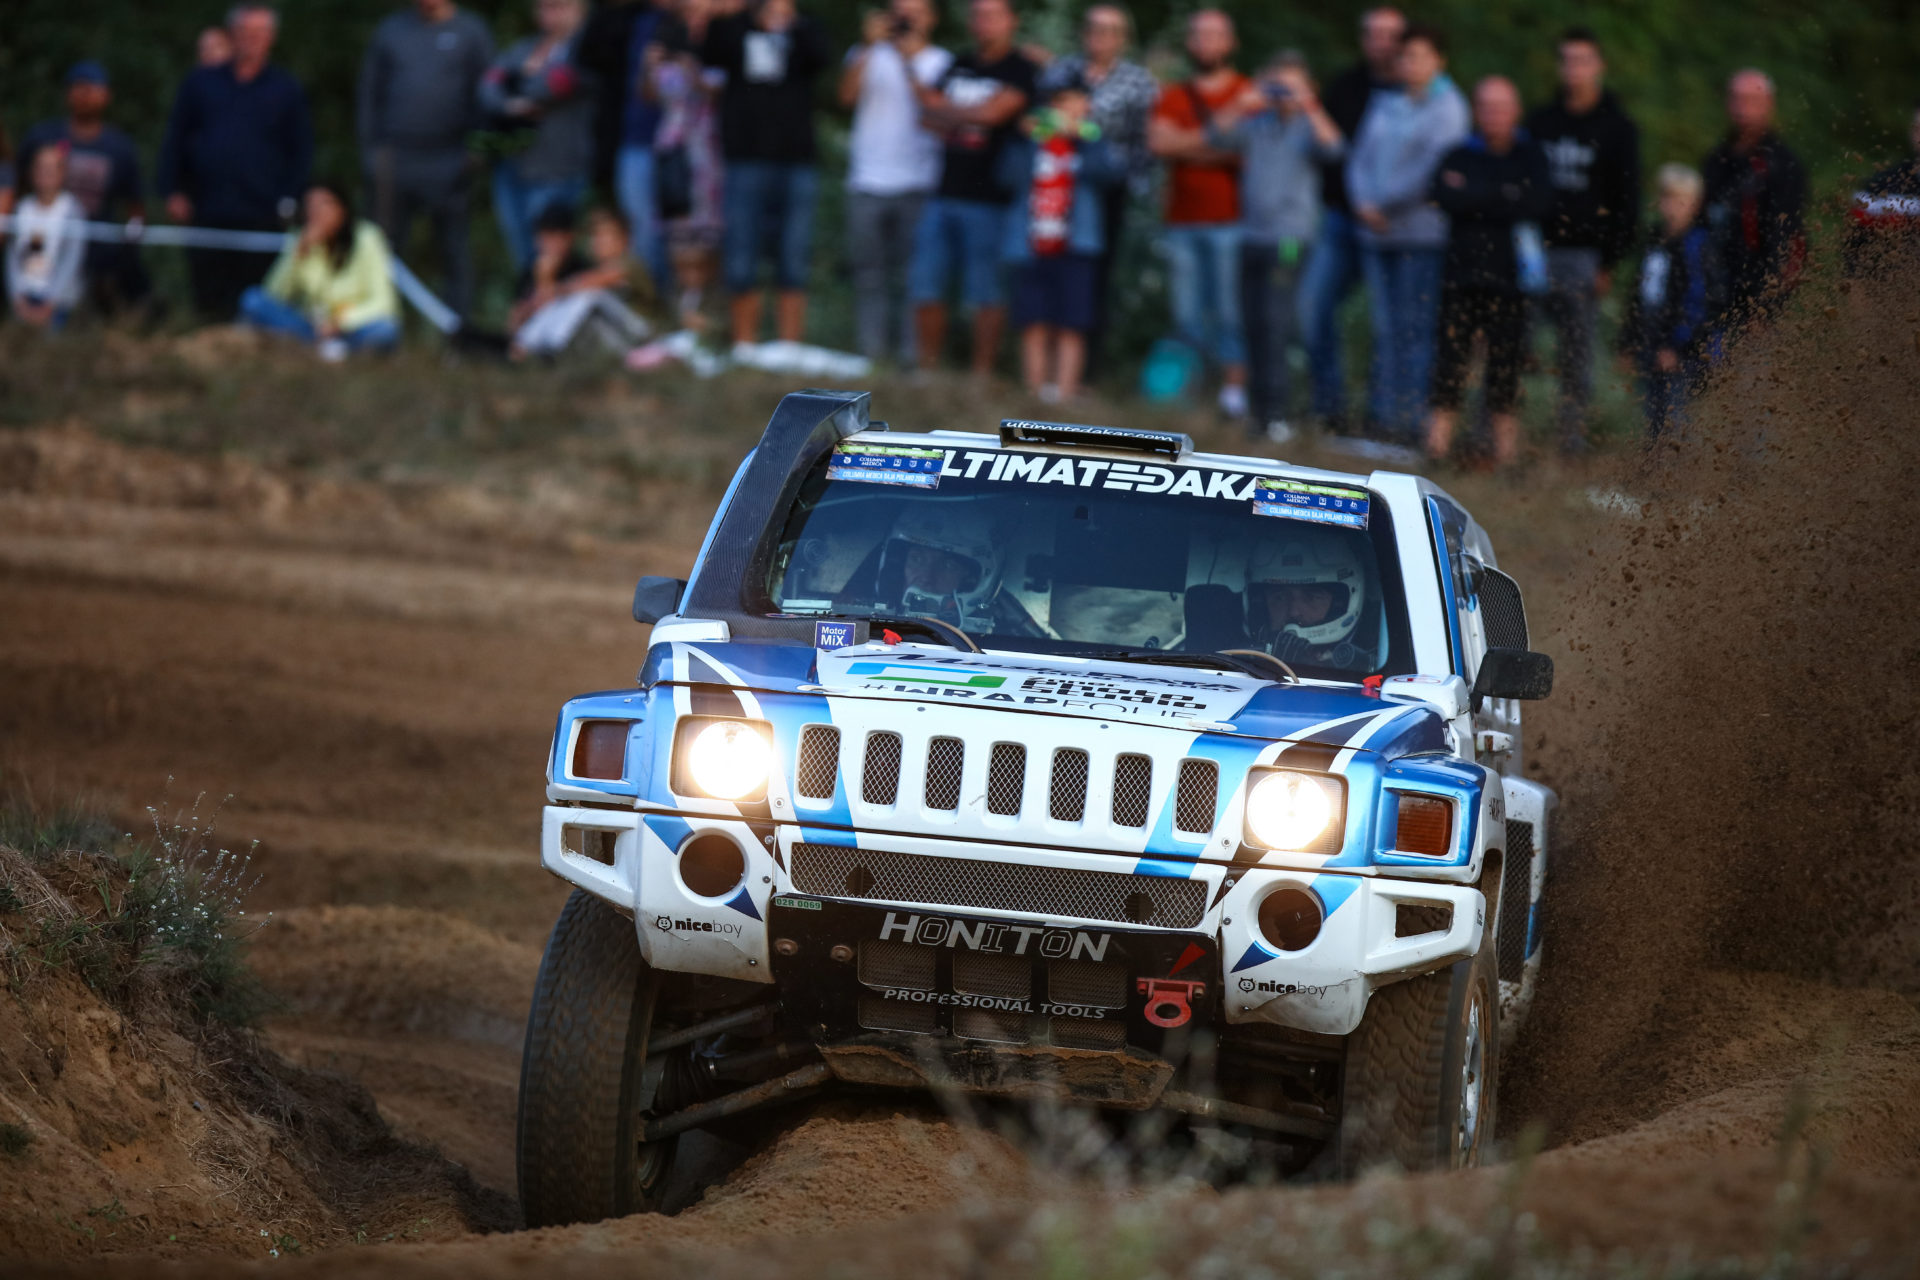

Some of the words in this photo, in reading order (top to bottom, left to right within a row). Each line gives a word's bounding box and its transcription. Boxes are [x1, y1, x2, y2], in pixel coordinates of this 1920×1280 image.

[1006, 421, 1173, 442] ultimatedakar.com
[934, 448, 1259, 501] LTIMATEDAKA
[821, 626, 847, 635] Motor
[776, 898, 794, 907] 02R
[797, 899, 821, 910] 0069
[675, 918, 743, 938] niceboy
[879, 912, 1110, 962] HONITON
[1258, 980, 1328, 1000] niceboy
[884, 989, 1034, 1015] PROFESSIONAL
[1039, 1002, 1106, 1020] TOOLS
